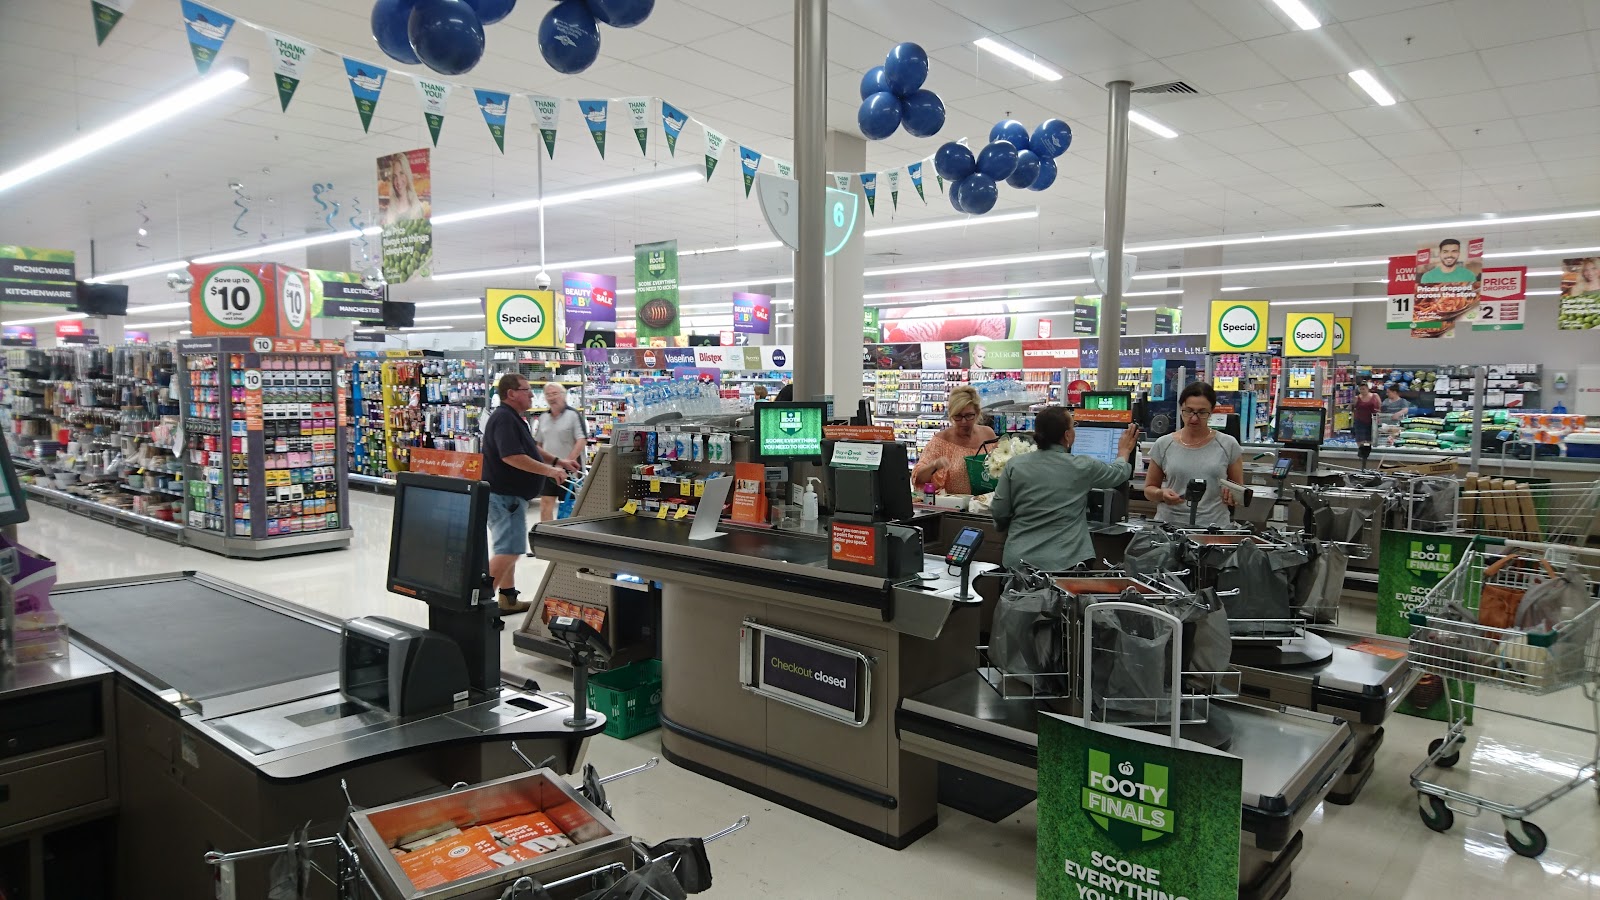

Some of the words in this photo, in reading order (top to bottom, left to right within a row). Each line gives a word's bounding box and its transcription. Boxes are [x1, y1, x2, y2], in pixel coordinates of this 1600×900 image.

[274, 38, 306, 55] THANK
[279, 48, 300, 61] YOU!
[420, 81, 446, 93] THANK
[424, 90, 442, 99] YOU!
[778, 191, 789, 216] 5
[833, 202, 844, 227] 6
[13, 265, 70, 275] PICNICWARE
[1484, 278, 1516, 286] PRICE
[5, 288, 71, 298] KITCHENWARE
[566, 288, 592, 296] BEAUTY
[210, 286, 250, 311] $10
[286, 289, 302, 314] $10
[566, 296, 591, 307] BABY
[596, 294, 613, 305] SALE
[734, 306, 753, 314] BEAUTY
[1393, 298, 1409, 312] $11
[502, 314, 540, 325] Special
[734, 313, 753, 322] BABY
[756, 312, 768, 320] SALE
[1223, 323, 1255, 332] Special
[1296, 332, 1323, 340] Special
[665, 354, 694, 363] Vaseline
[699, 353, 722, 364] Blistex
[1411, 551, 1450, 561] FOOTY
[1410, 560, 1449, 571] FINALS
[771, 657, 813, 678] Checkout
[814, 671, 846, 688] closed
[1089, 770, 1166, 804] FOOTY
[1088, 792, 1166, 828] FINALS
[1091, 851, 1160, 886] SCORE
[1065, 859, 1190, 900] EVERYTHIN
